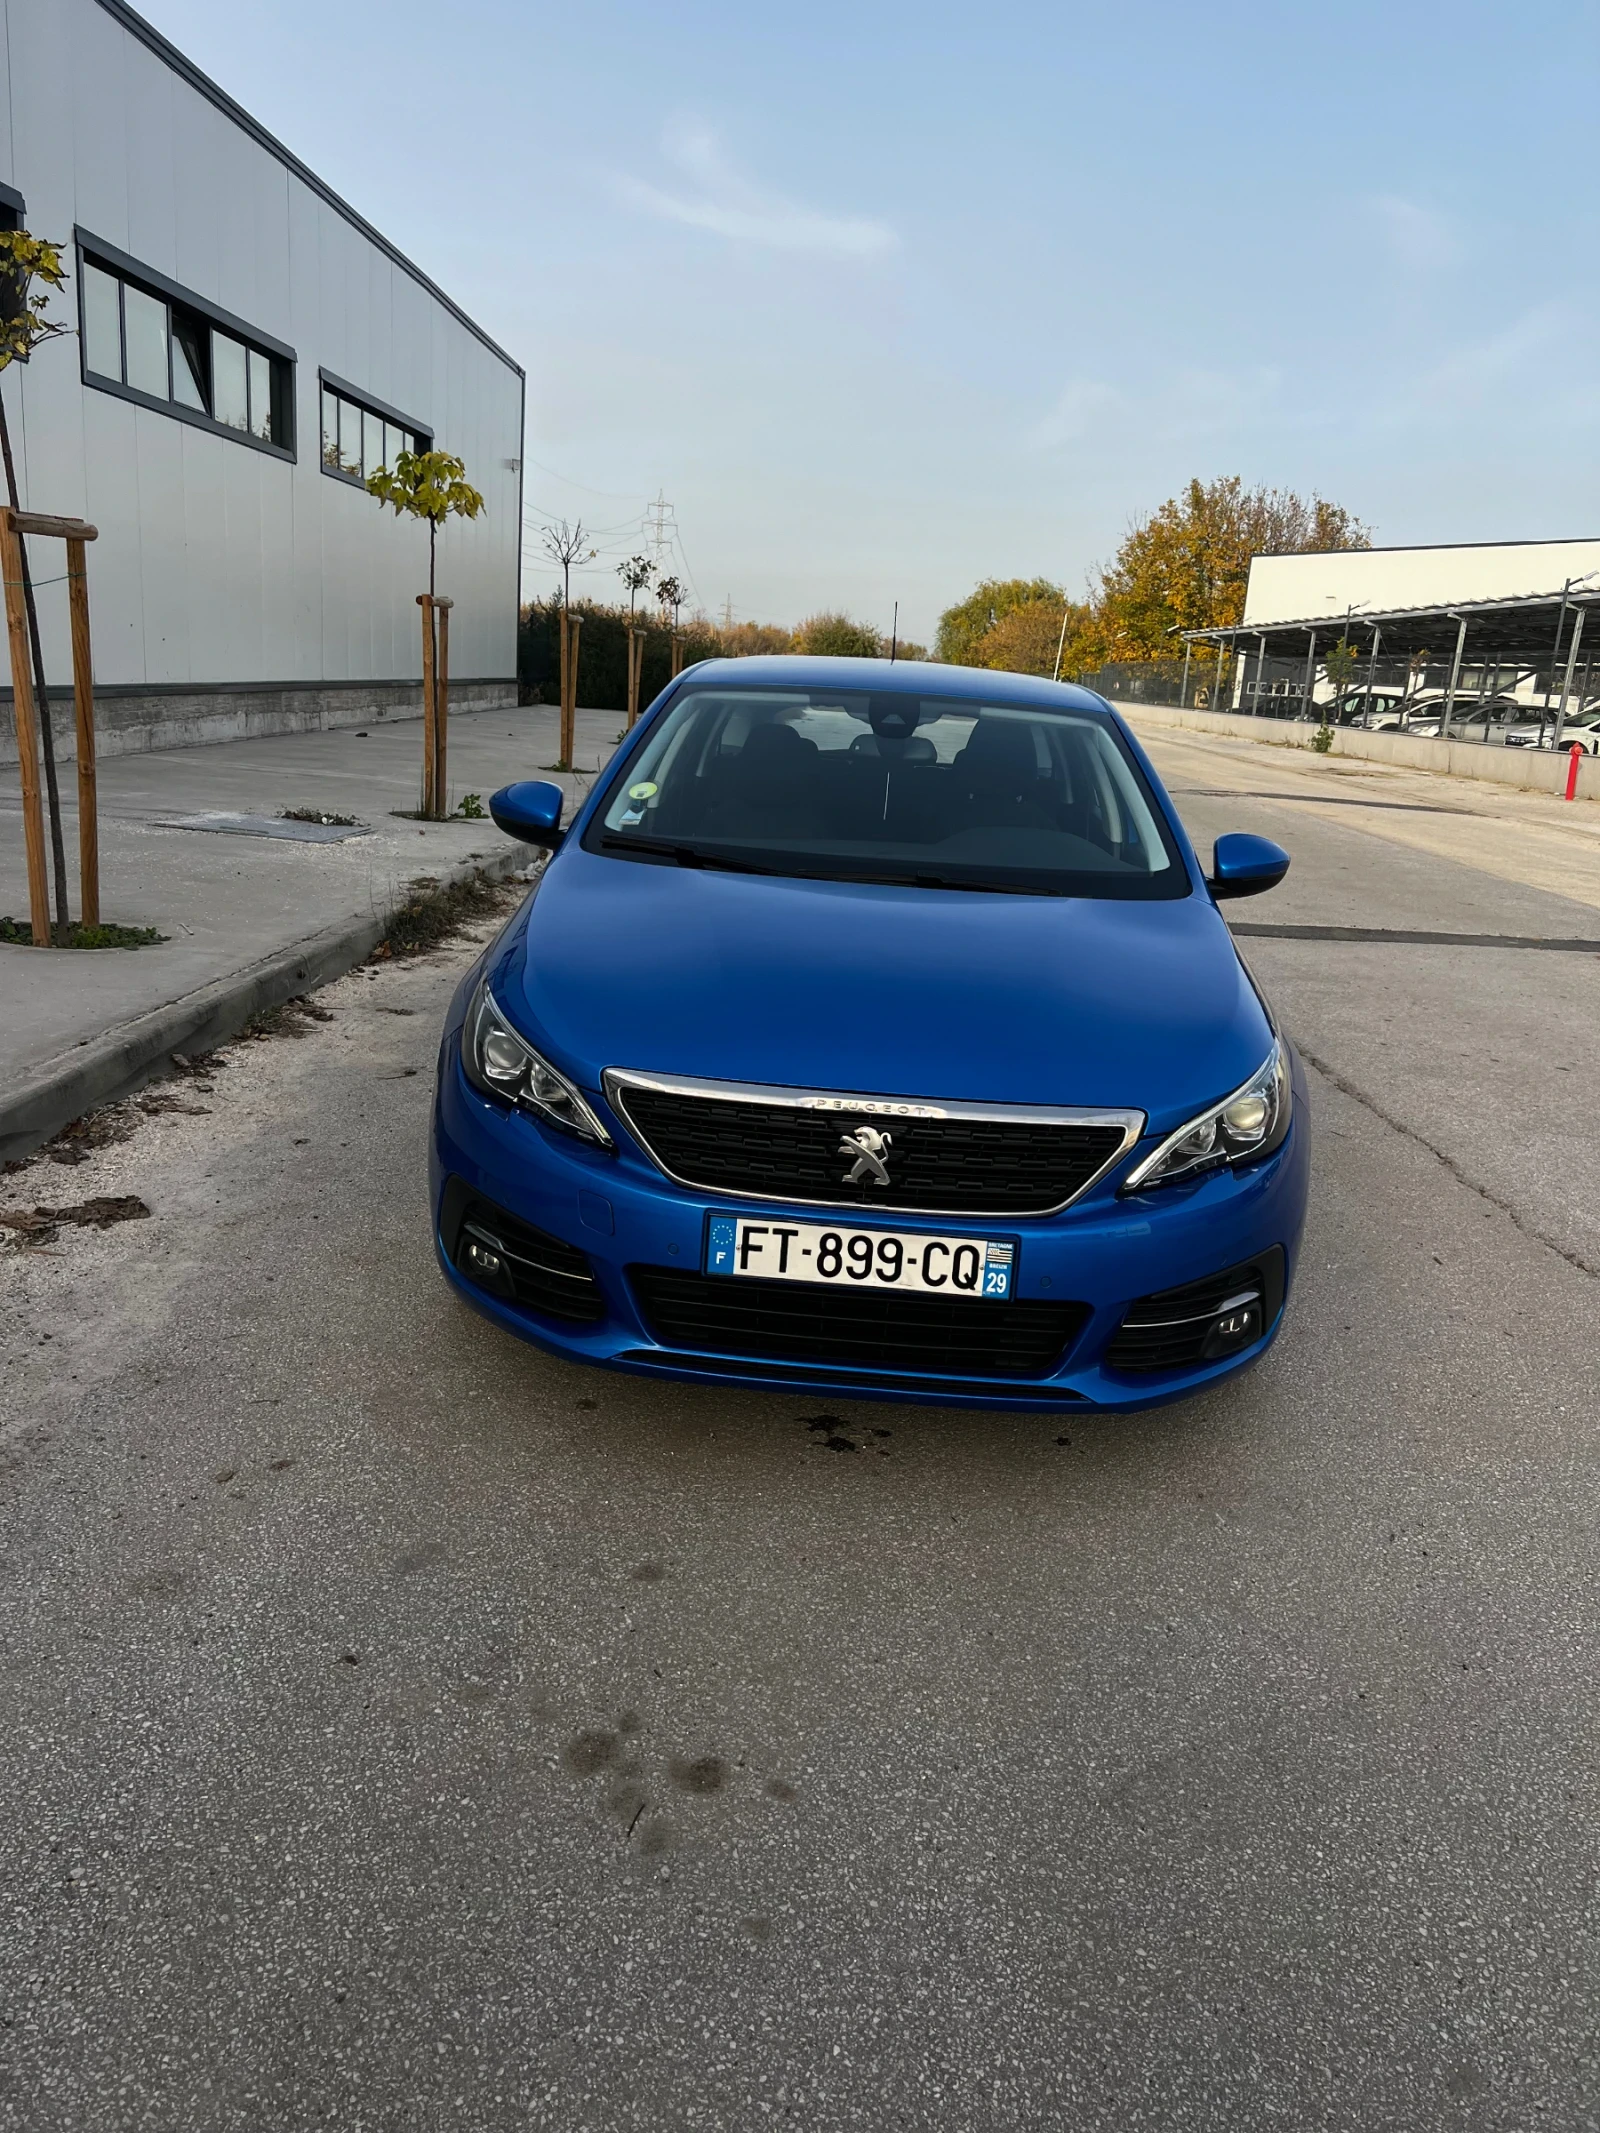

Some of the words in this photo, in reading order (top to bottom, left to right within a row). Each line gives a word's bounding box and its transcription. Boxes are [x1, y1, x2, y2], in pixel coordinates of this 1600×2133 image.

[815, 1098, 926, 1116] PEUGEOT
[715, 1251, 727, 1265] F
[740, 1225, 980, 1291] FT-899-CQ
[986, 1272, 1007, 1294] 29
